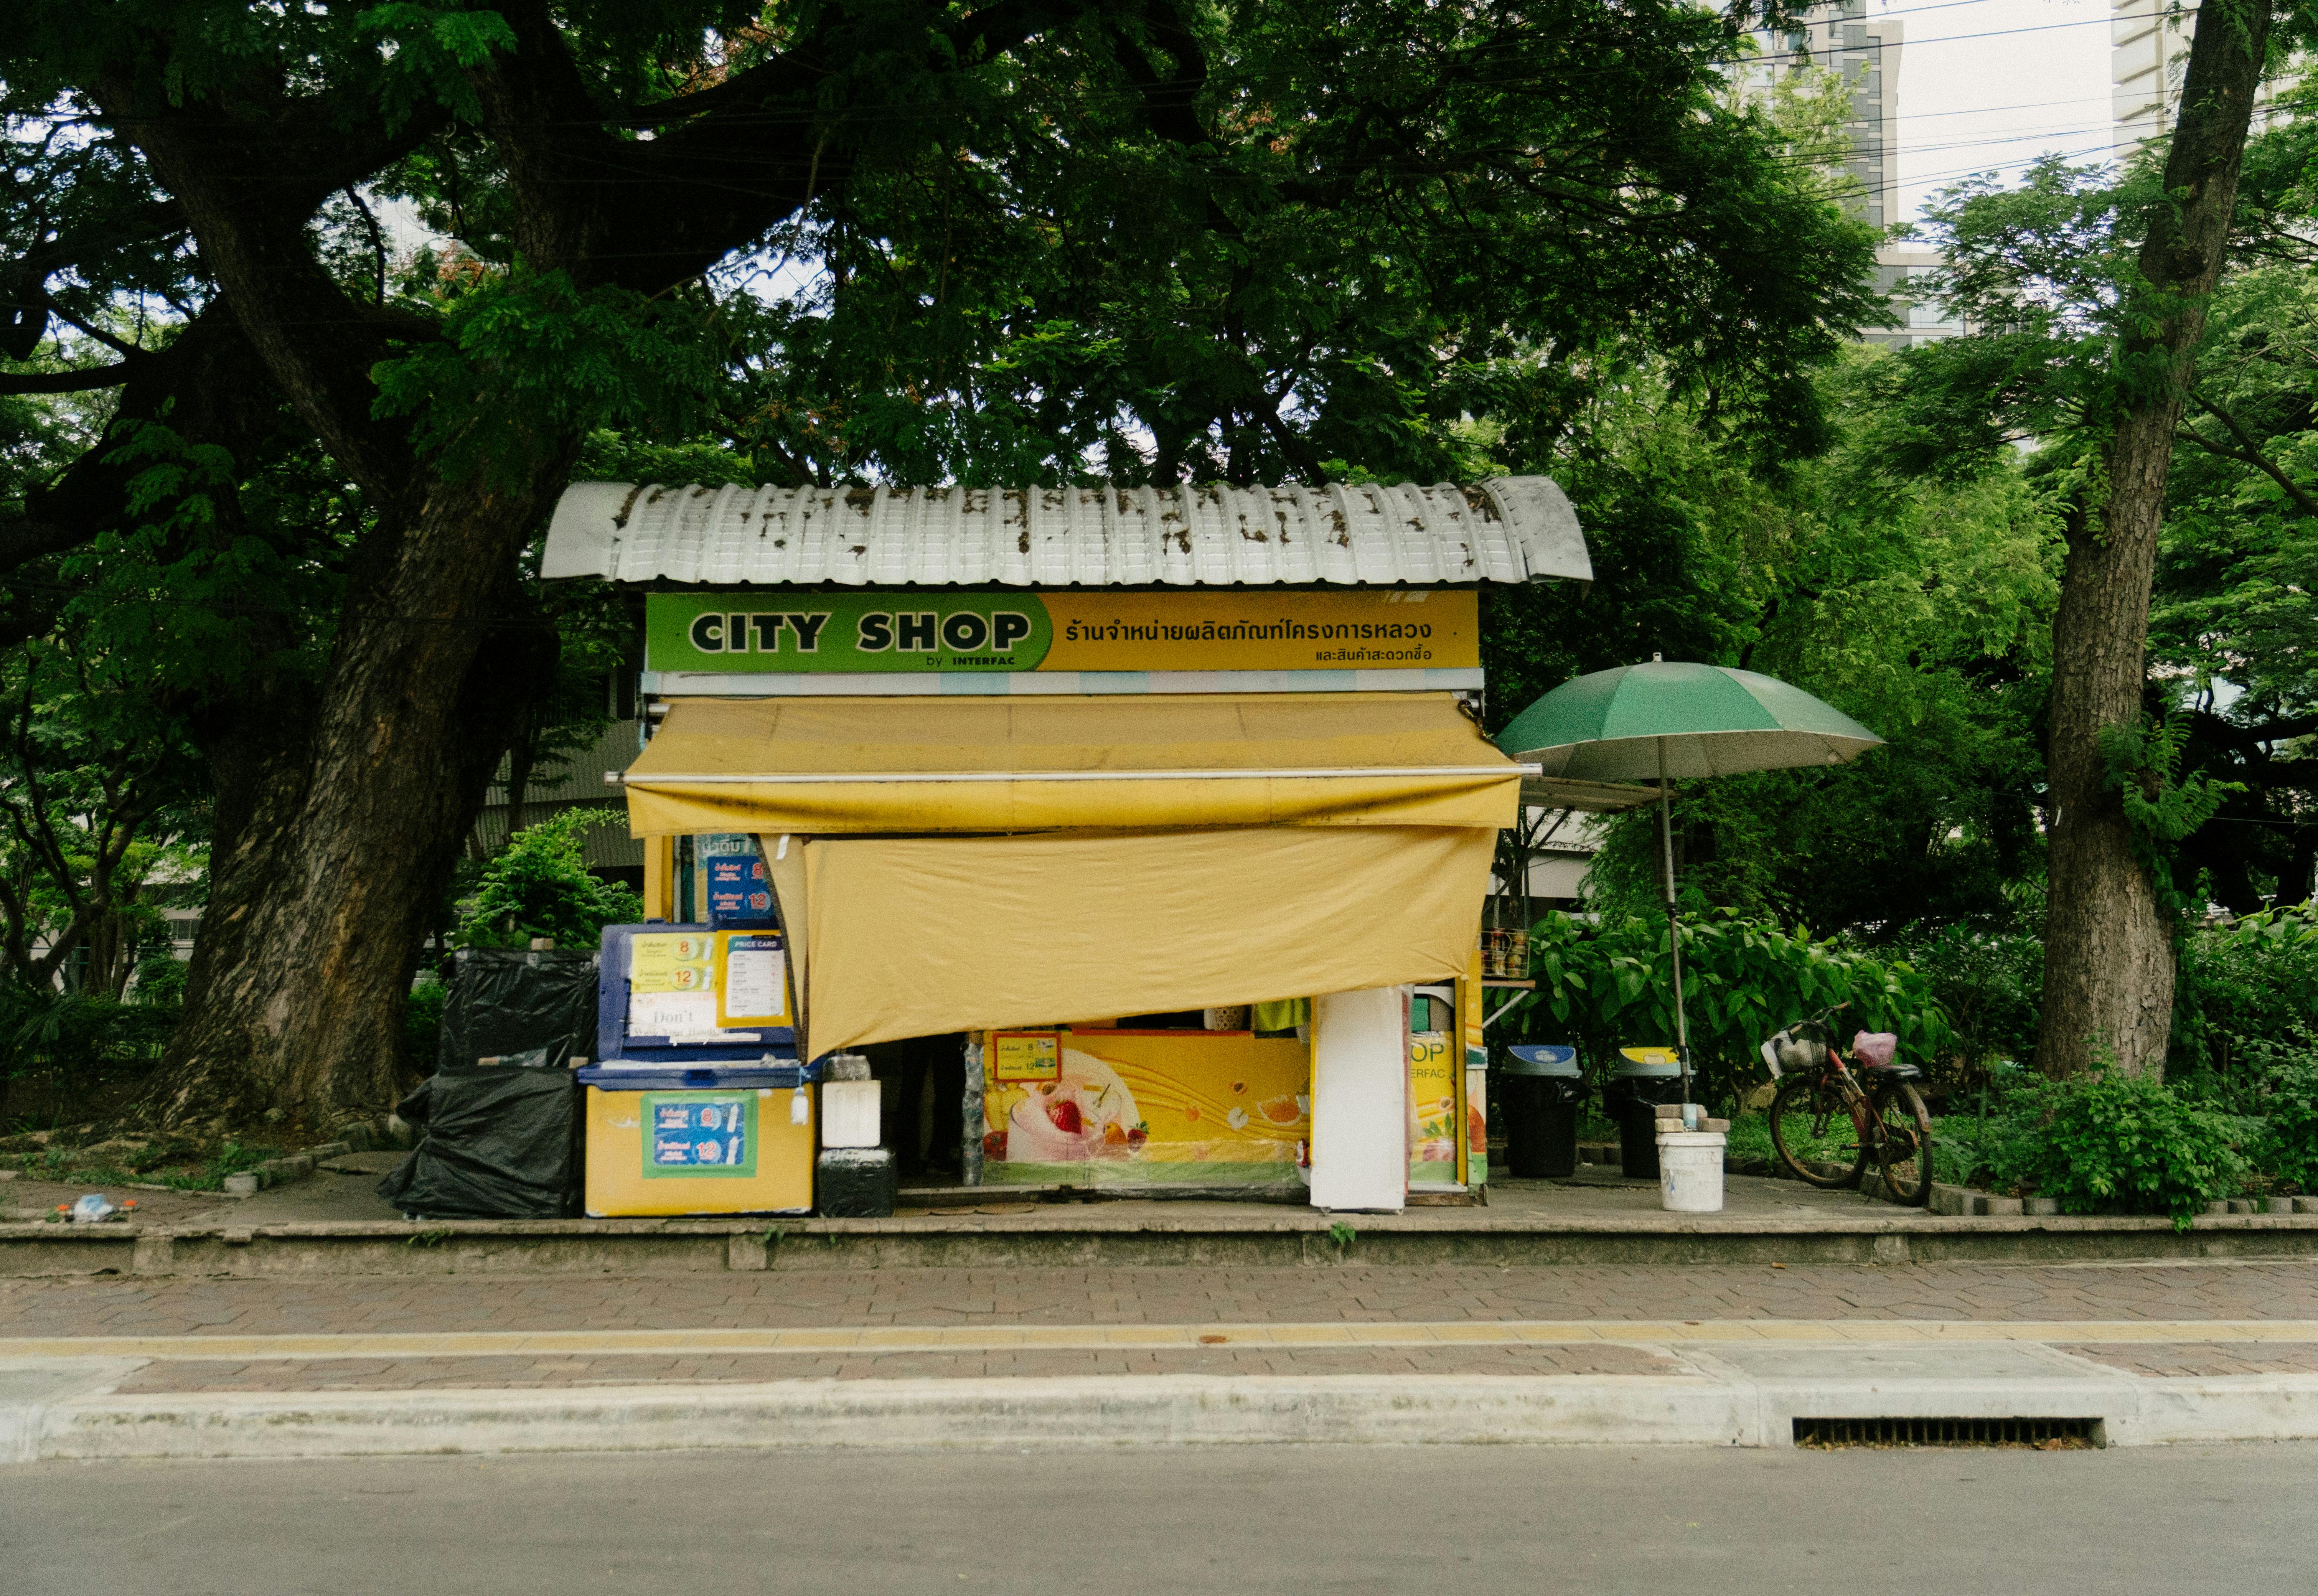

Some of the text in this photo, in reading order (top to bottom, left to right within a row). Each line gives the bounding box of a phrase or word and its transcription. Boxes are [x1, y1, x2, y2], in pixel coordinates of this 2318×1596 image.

[689, 611, 1031, 653] CITY SHOP
[927, 656, 942, 667] by
[749, 893, 766, 906] 12
[680, 941, 689, 952] 8
[676, 970, 691, 982] 12
[697, 1142, 716, 1156] 12
